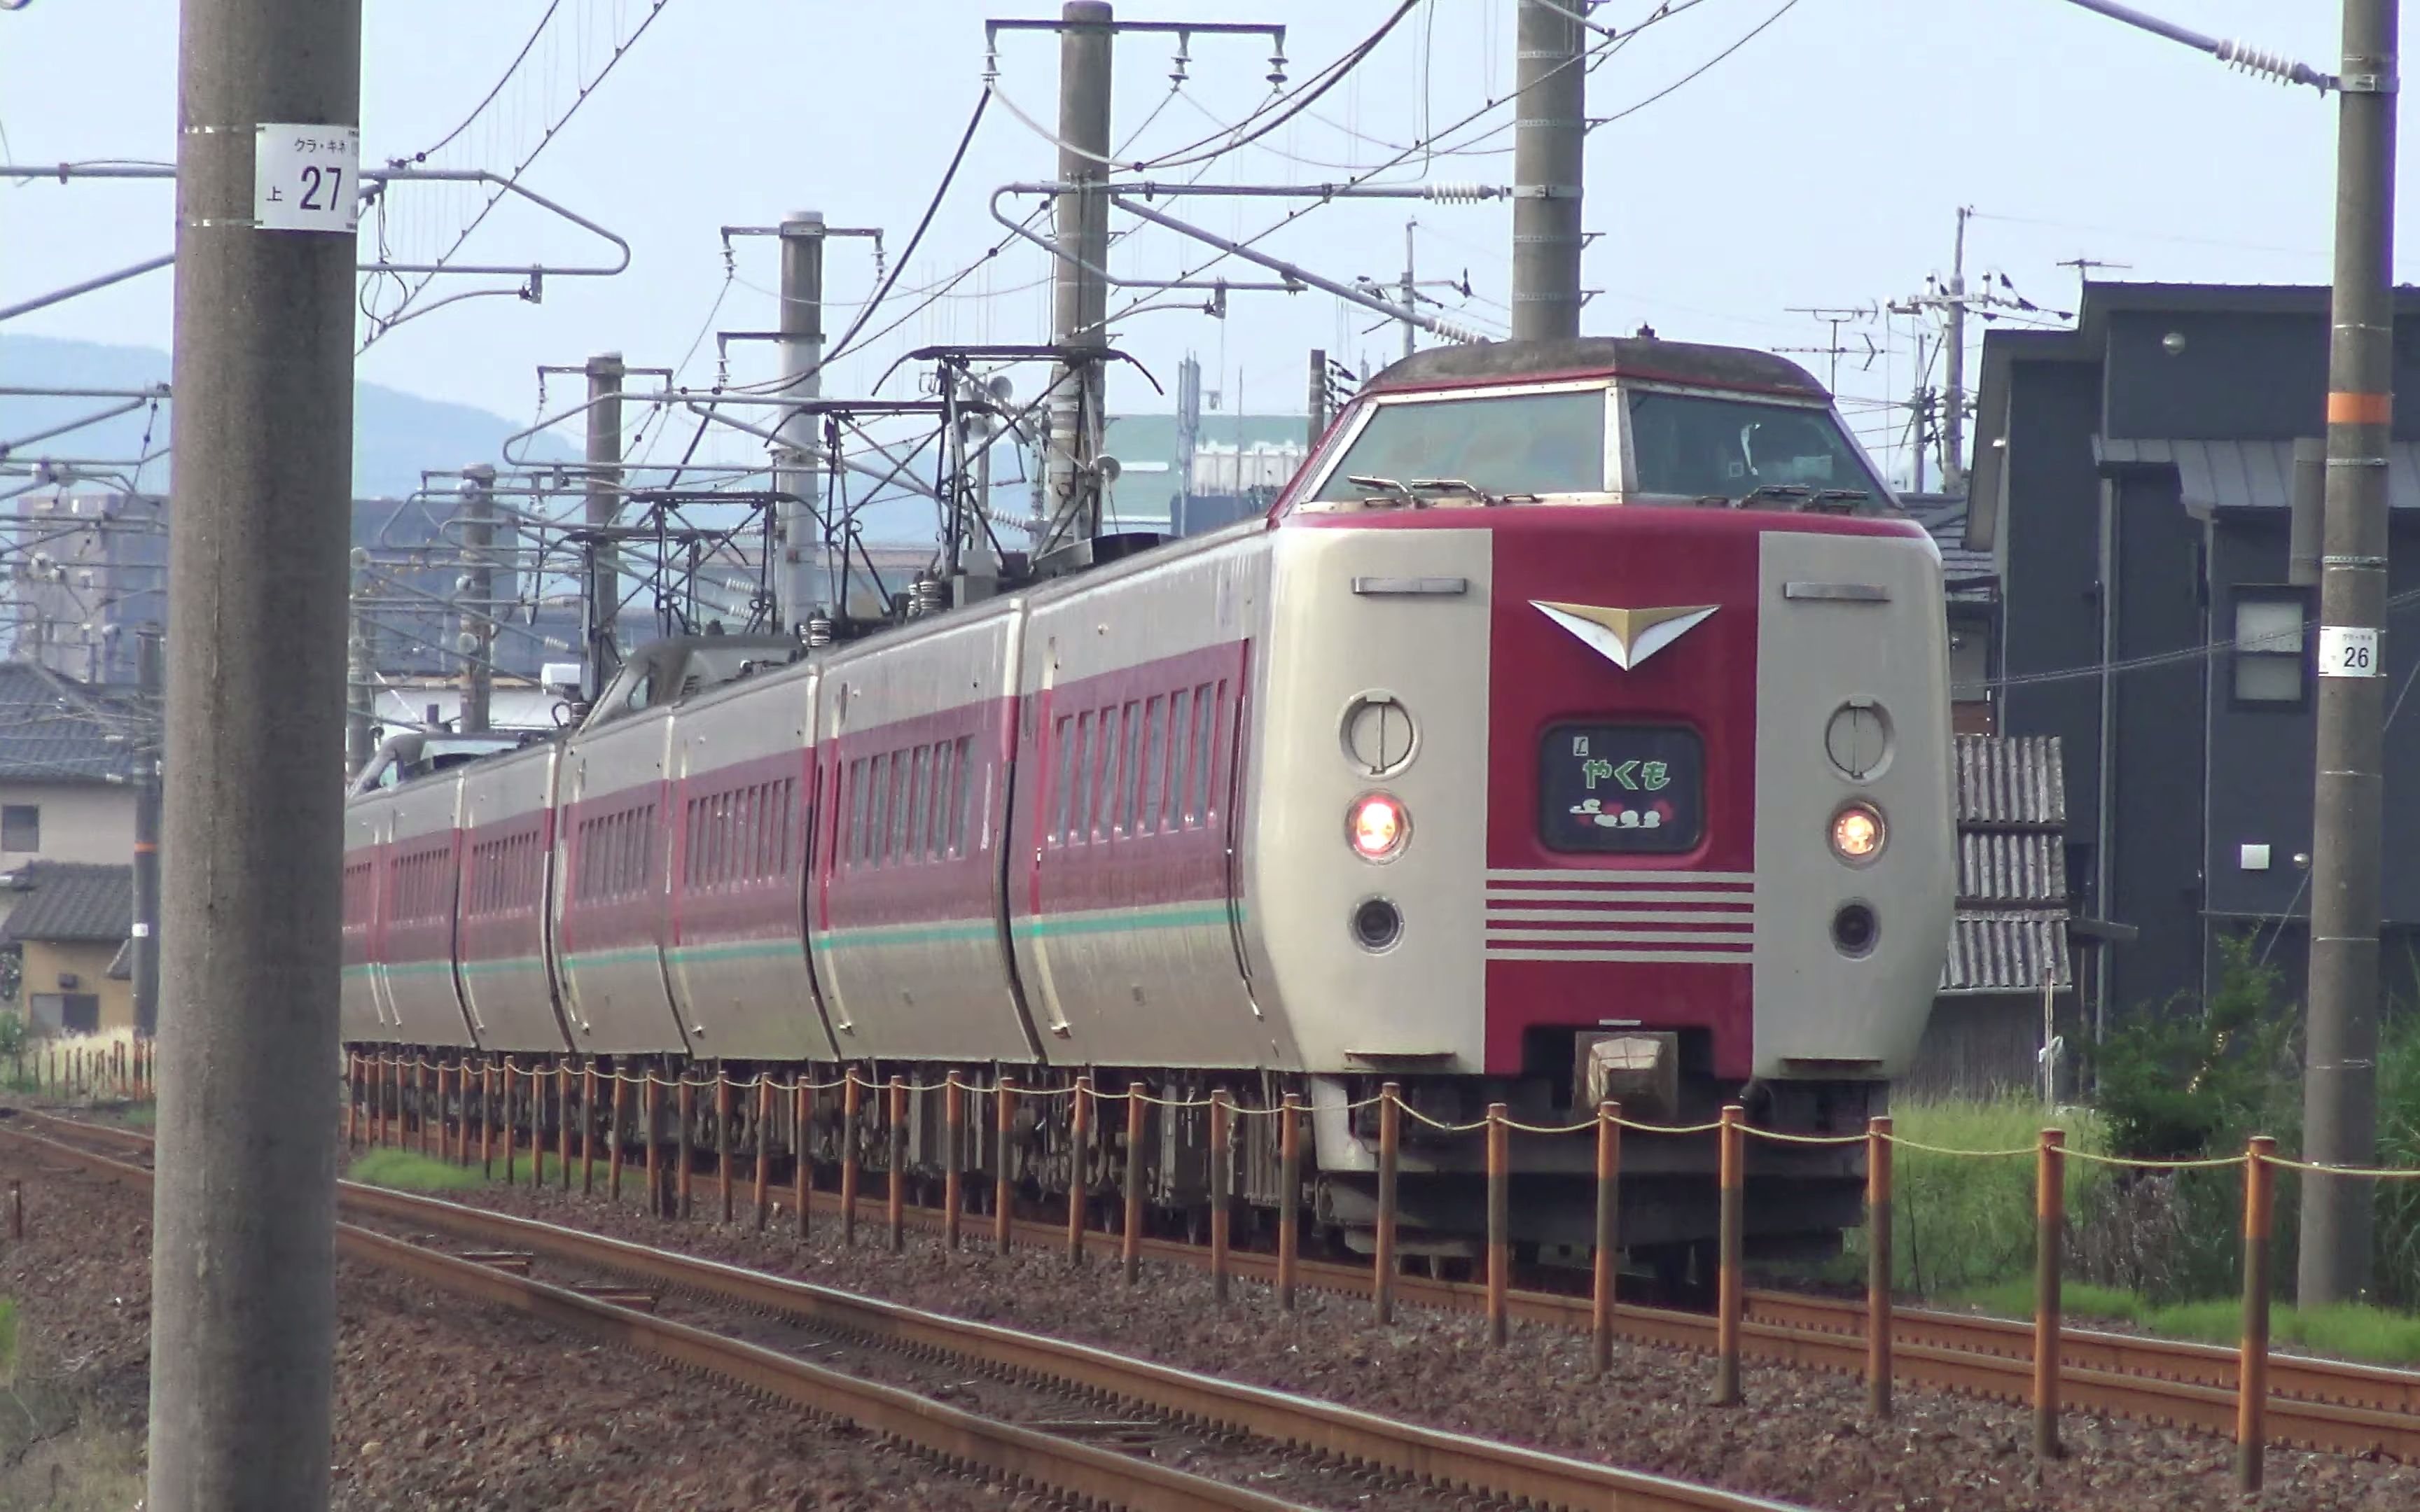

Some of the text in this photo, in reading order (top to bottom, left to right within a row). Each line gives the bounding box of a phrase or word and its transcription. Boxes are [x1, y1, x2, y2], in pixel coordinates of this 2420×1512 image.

[266, 165, 342, 211] 上 27
[2344, 646, 2369, 668] 26
[1583, 759, 1671, 790] やくも
